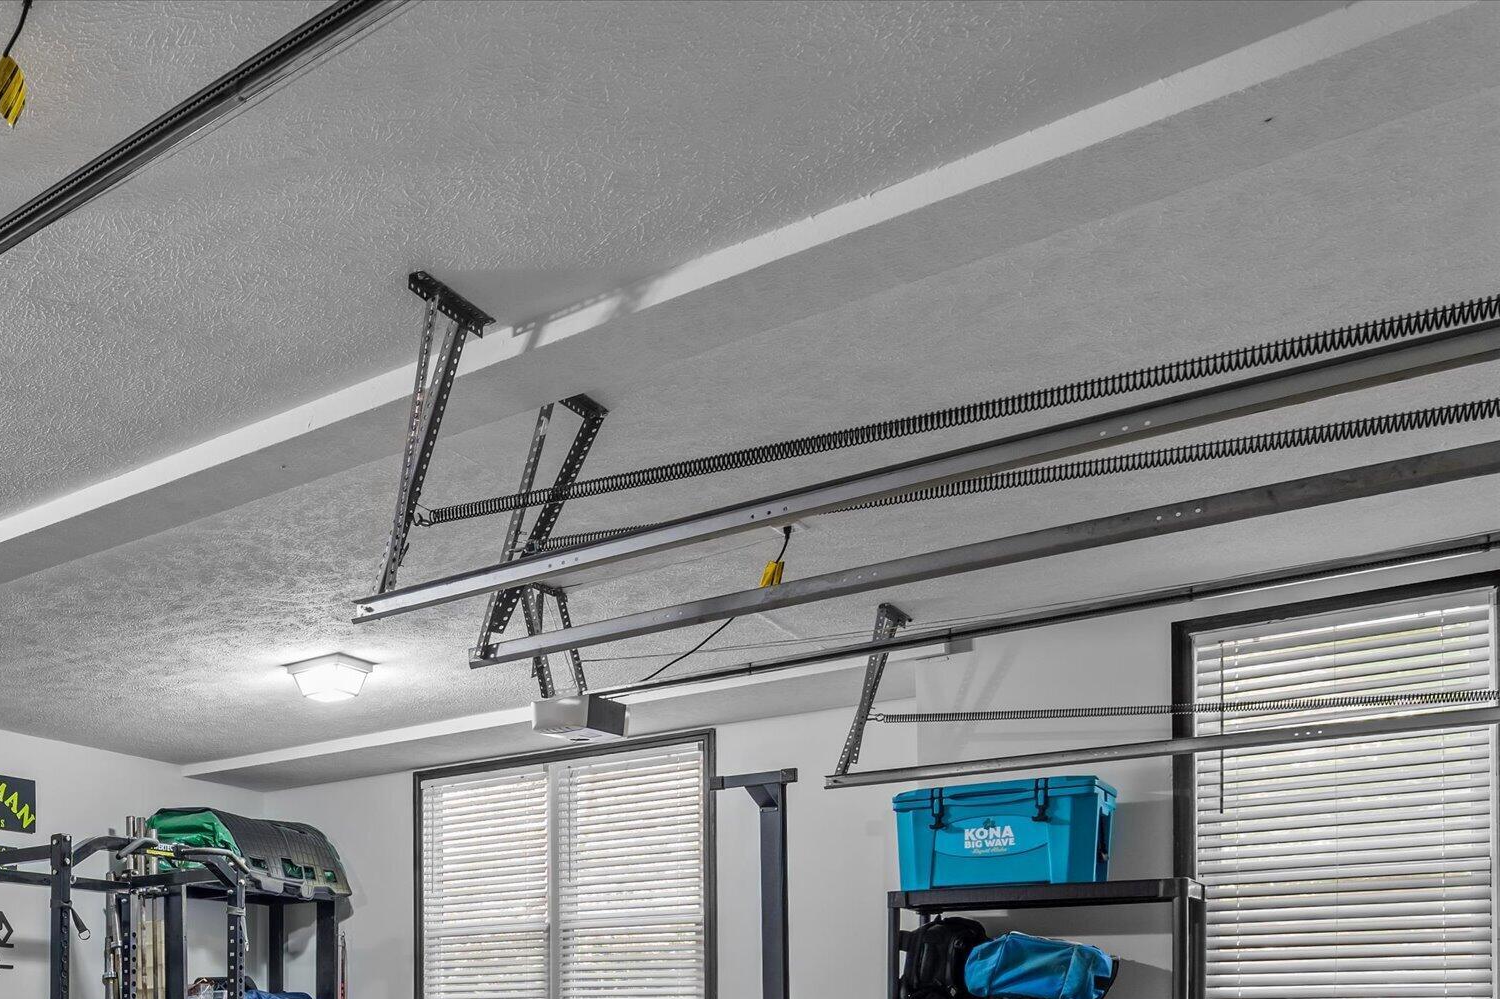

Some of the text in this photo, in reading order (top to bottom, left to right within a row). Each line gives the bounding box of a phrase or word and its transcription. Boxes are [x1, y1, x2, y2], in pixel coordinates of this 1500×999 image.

[964, 825, 1014, 840] KONA
[964, 838, 1016, 849] BIG WAVE
